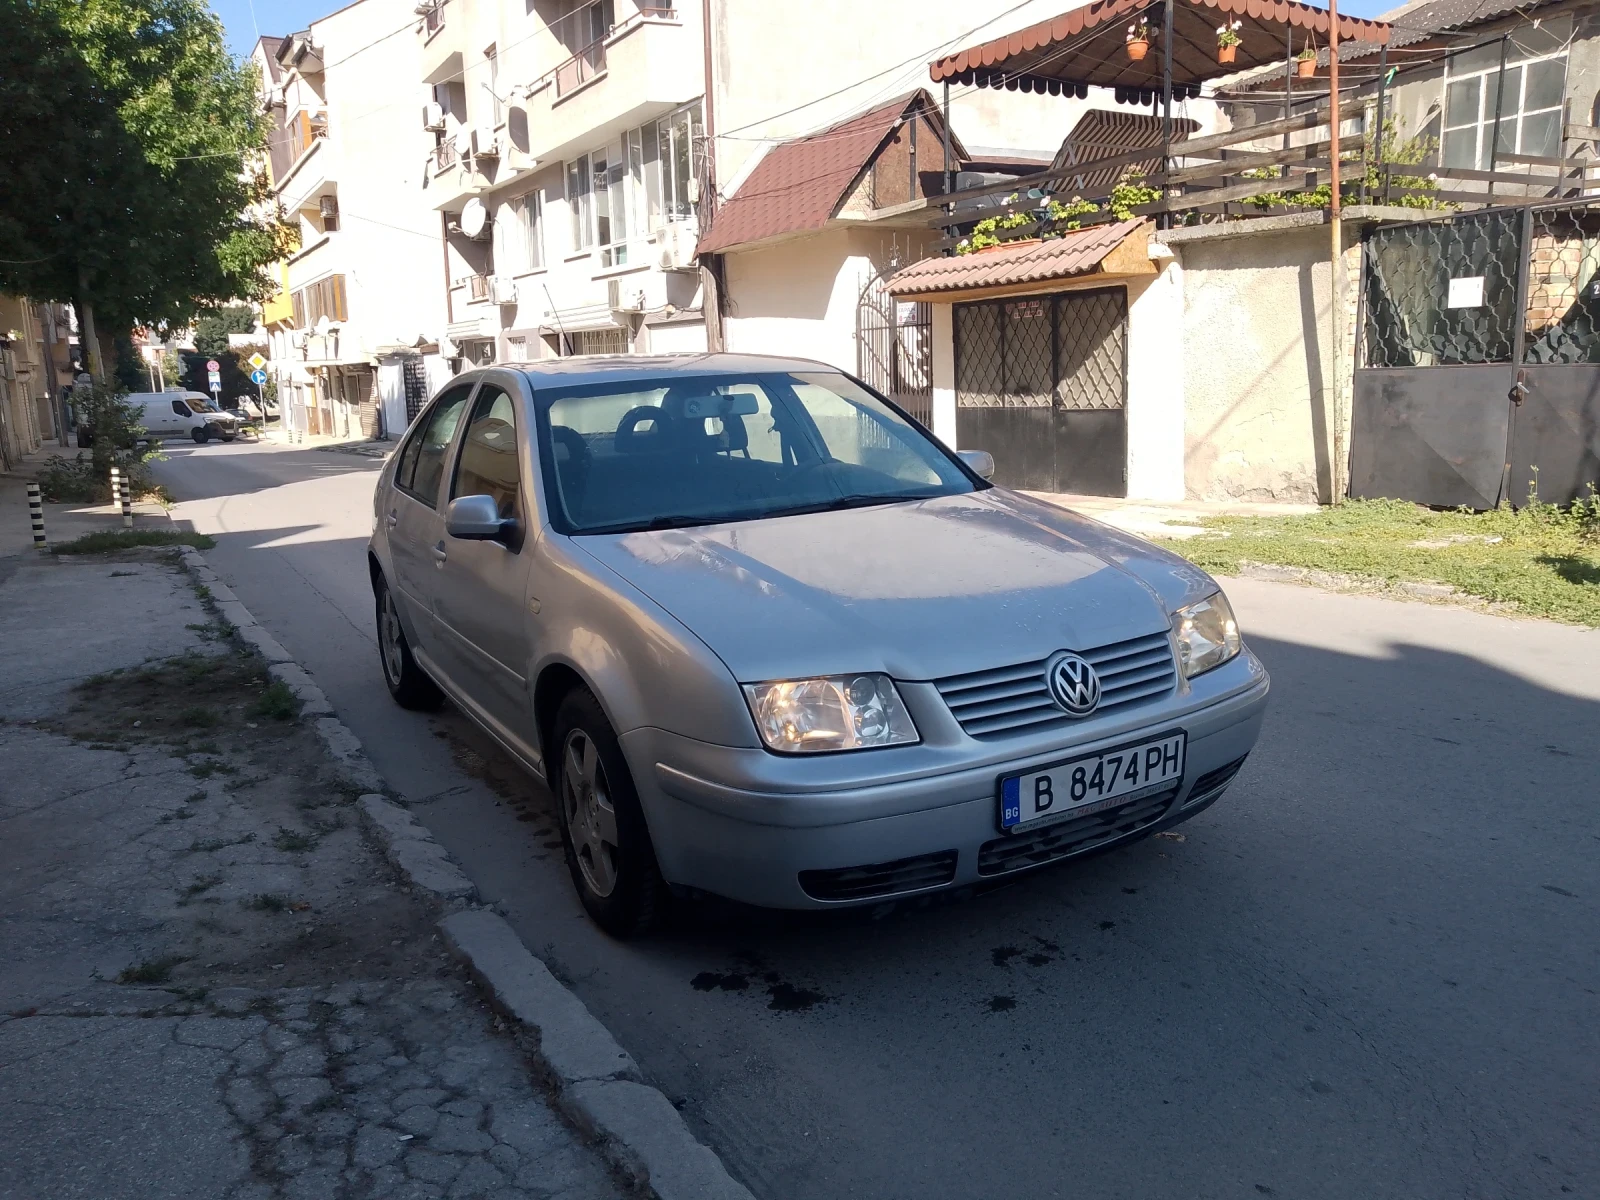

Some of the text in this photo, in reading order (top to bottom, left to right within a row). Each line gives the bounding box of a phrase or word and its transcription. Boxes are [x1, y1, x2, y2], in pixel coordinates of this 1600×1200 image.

[1055, 657, 1099, 709] VW
[1034, 740, 1180, 813] B 8474 PH
[1005, 806, 1019, 820] BG
